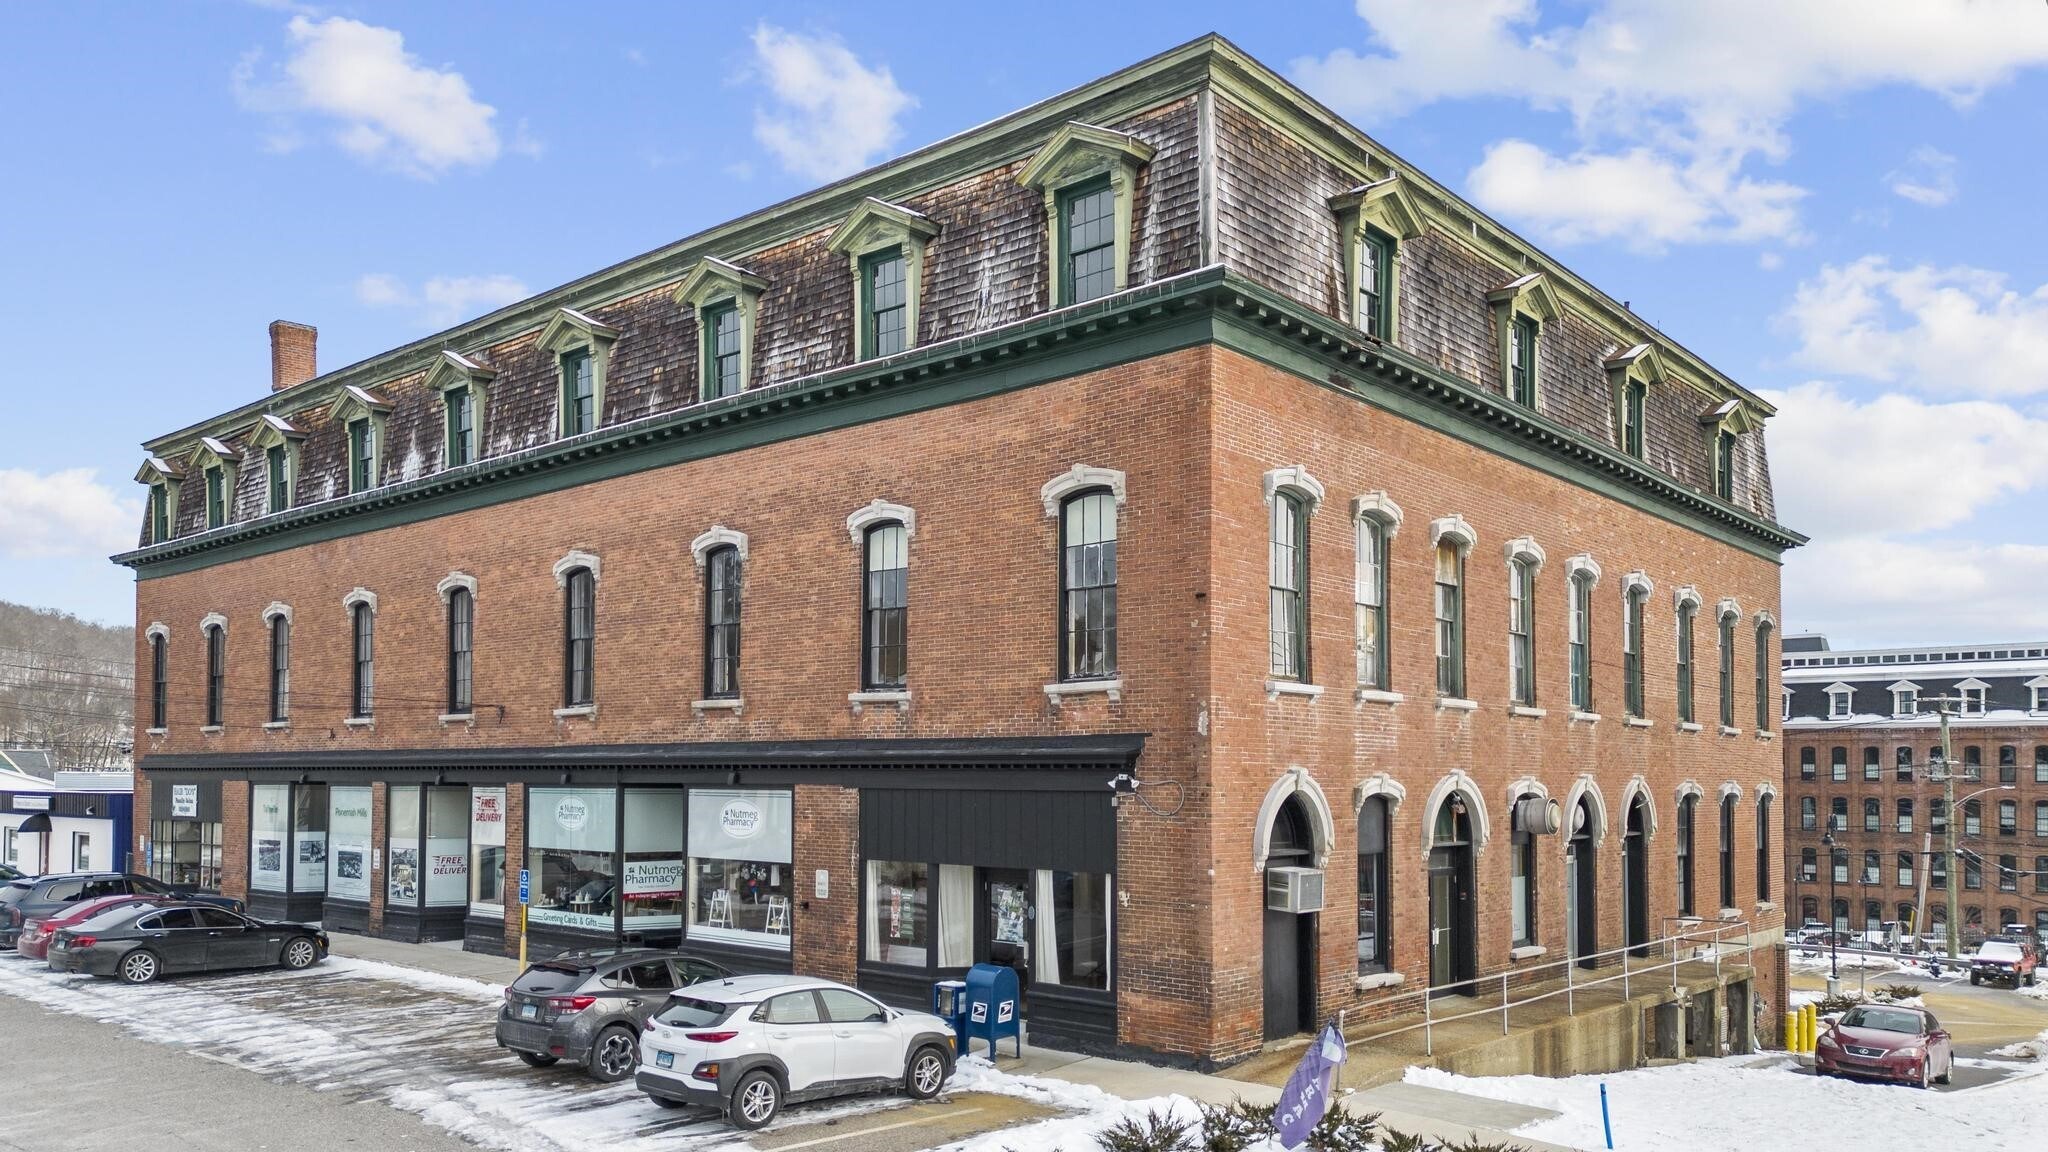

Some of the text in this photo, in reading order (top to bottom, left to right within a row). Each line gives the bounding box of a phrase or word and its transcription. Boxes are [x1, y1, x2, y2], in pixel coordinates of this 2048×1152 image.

[481, 799, 495, 808] FREE
[564, 804, 585, 816] Nutmeg
[731, 809, 758, 821] Nutmeg
[475, 812, 502, 822] DELIVERY
[723, 816, 753, 828] Pharmacy
[440, 856, 463, 865] FREE
[433, 867, 467, 875] DELIVER
[638, 865, 684, 877] Nutmeg
[625, 874, 677, 885] Pharmacy
[543, 912, 564, 924] Greeting
[564, 914, 578, 925] Cards
[585, 917, 598, 927] Gifts
